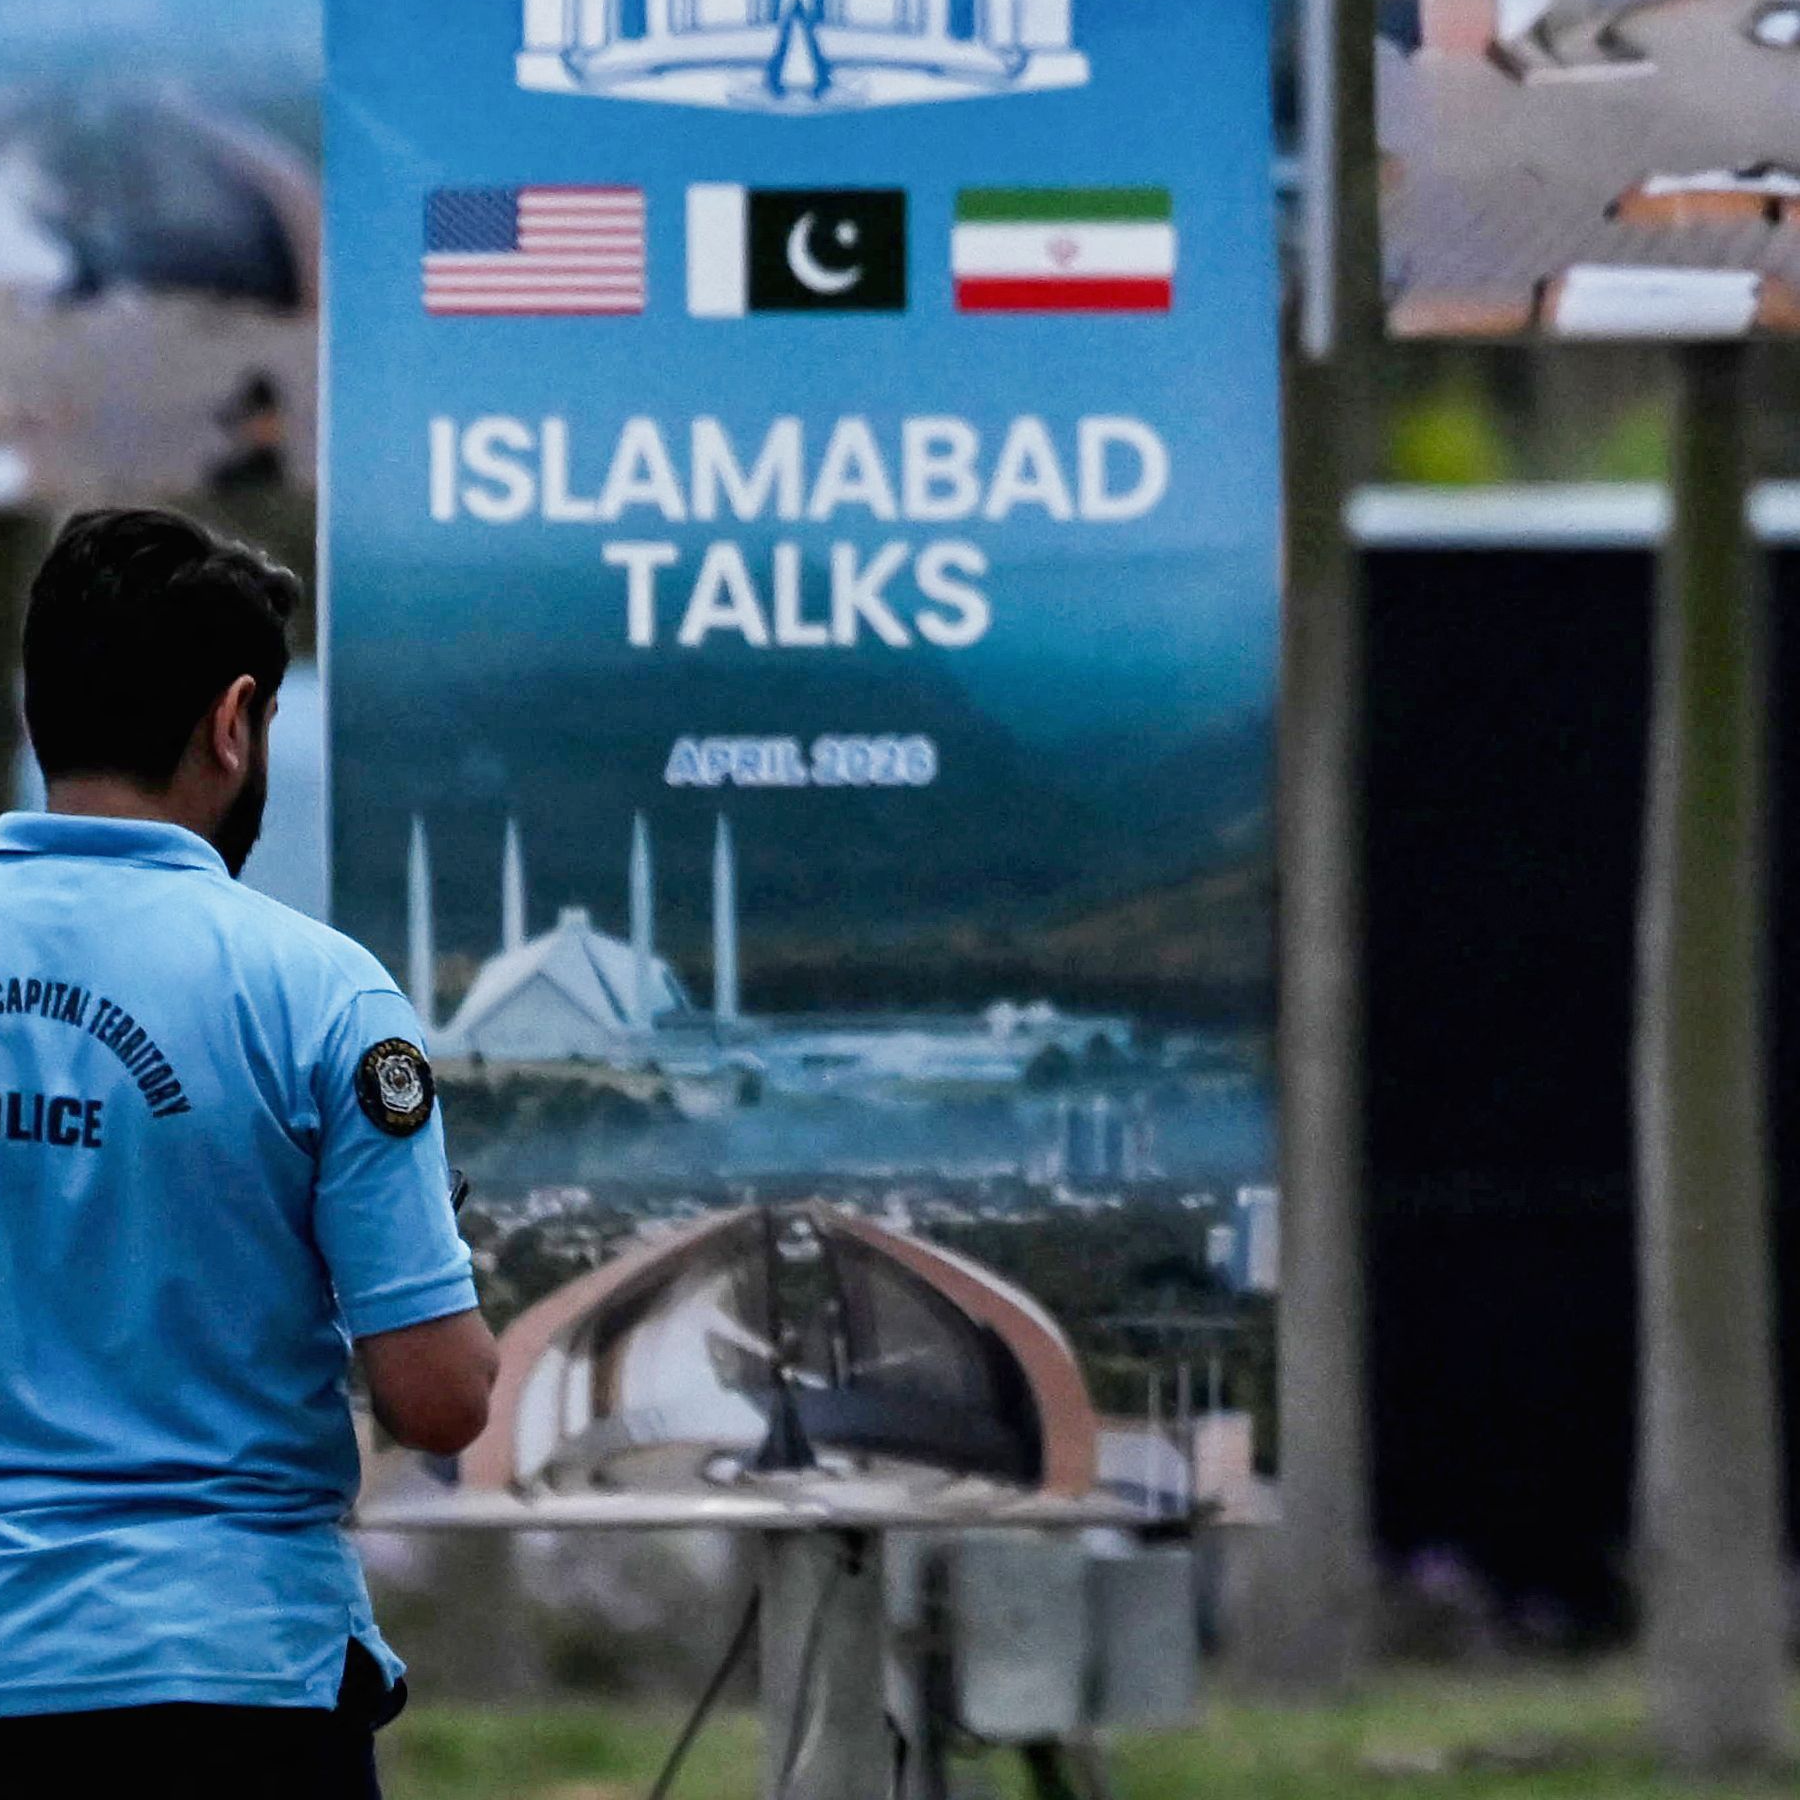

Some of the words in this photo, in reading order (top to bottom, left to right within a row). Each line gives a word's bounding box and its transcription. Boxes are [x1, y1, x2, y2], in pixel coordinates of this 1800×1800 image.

[428, 414, 1171, 524] ISLAMABAD
[601, 538, 992, 648] TALKS
[664, 736, 807, 787] APRIL
[89, 997, 192, 1118] TERRITORY
